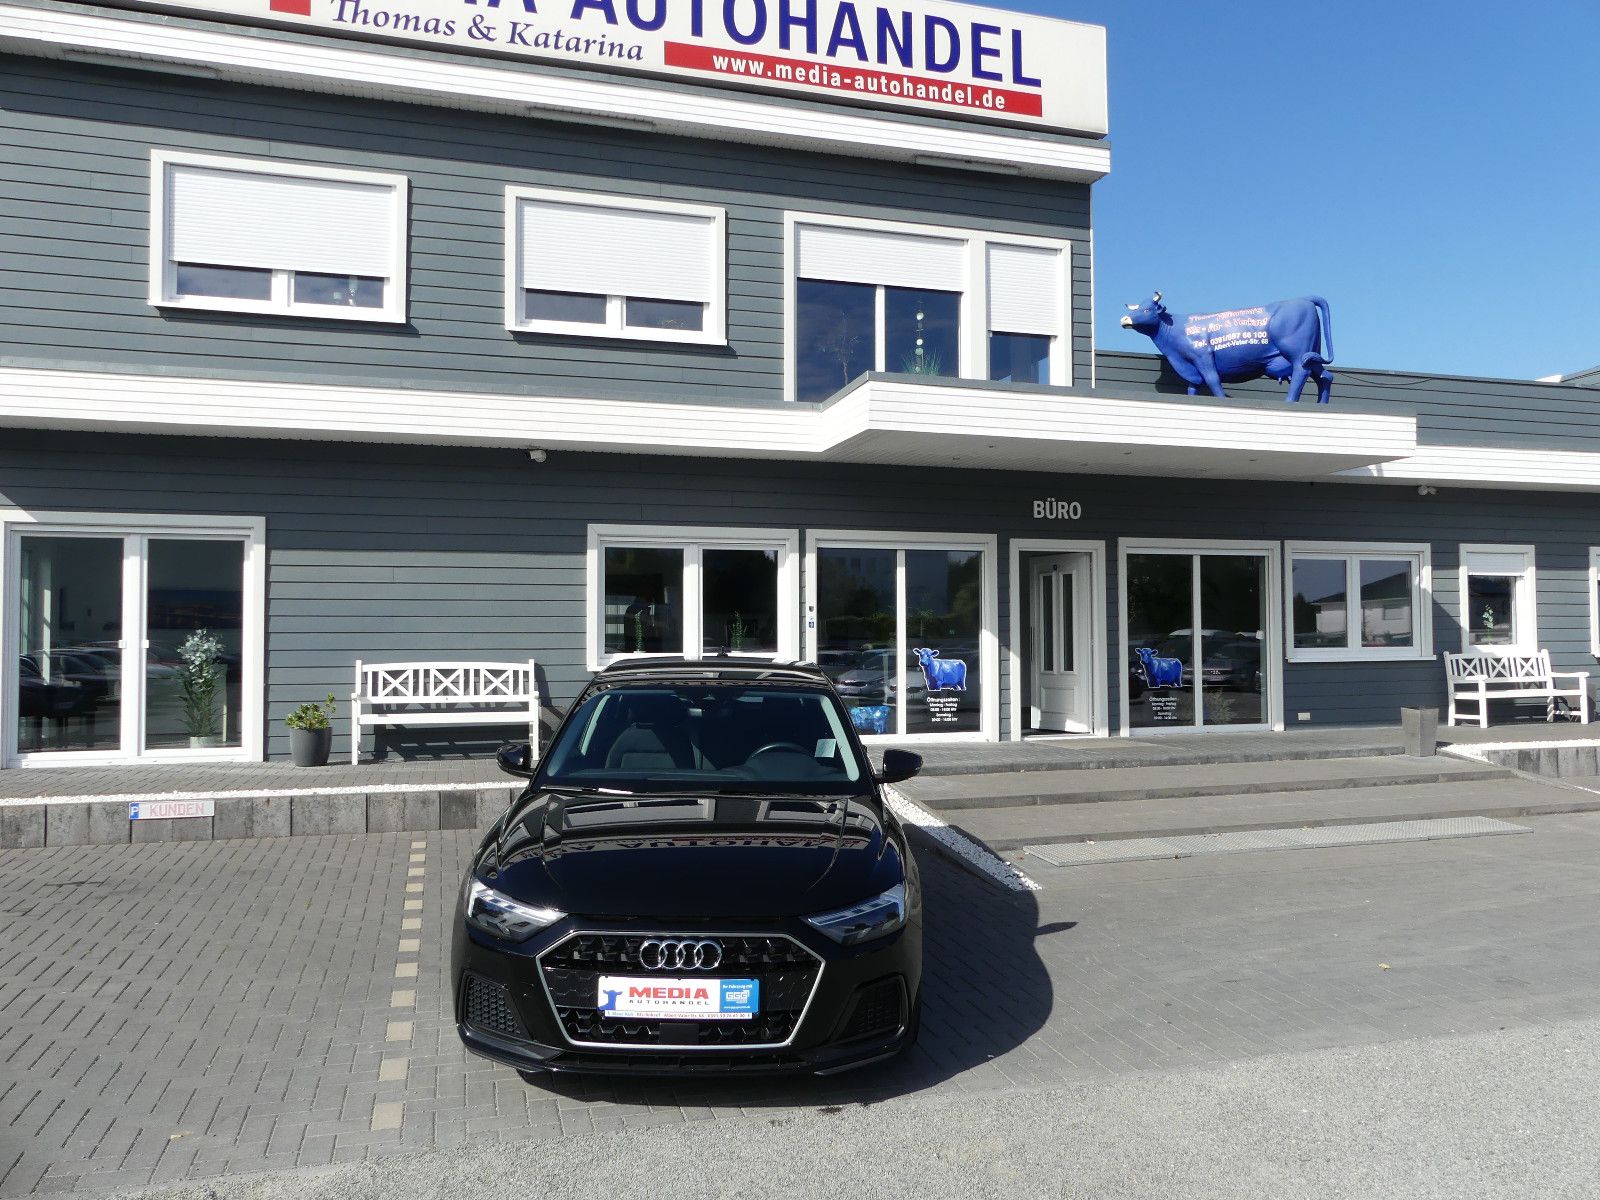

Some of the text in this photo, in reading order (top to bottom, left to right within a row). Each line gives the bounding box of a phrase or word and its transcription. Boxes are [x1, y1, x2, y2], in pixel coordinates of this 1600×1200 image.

[332, 0, 644, 60] Thomas & Katarina
[712, 52, 1006, 110] www.media-autohandel.de
[1033, 497, 1082, 520] BÜRO
[130, 803, 205, 817] P KUNDEN
[628, 986, 709, 999] MEDIA
[726, 991, 748, 1000] GGG
